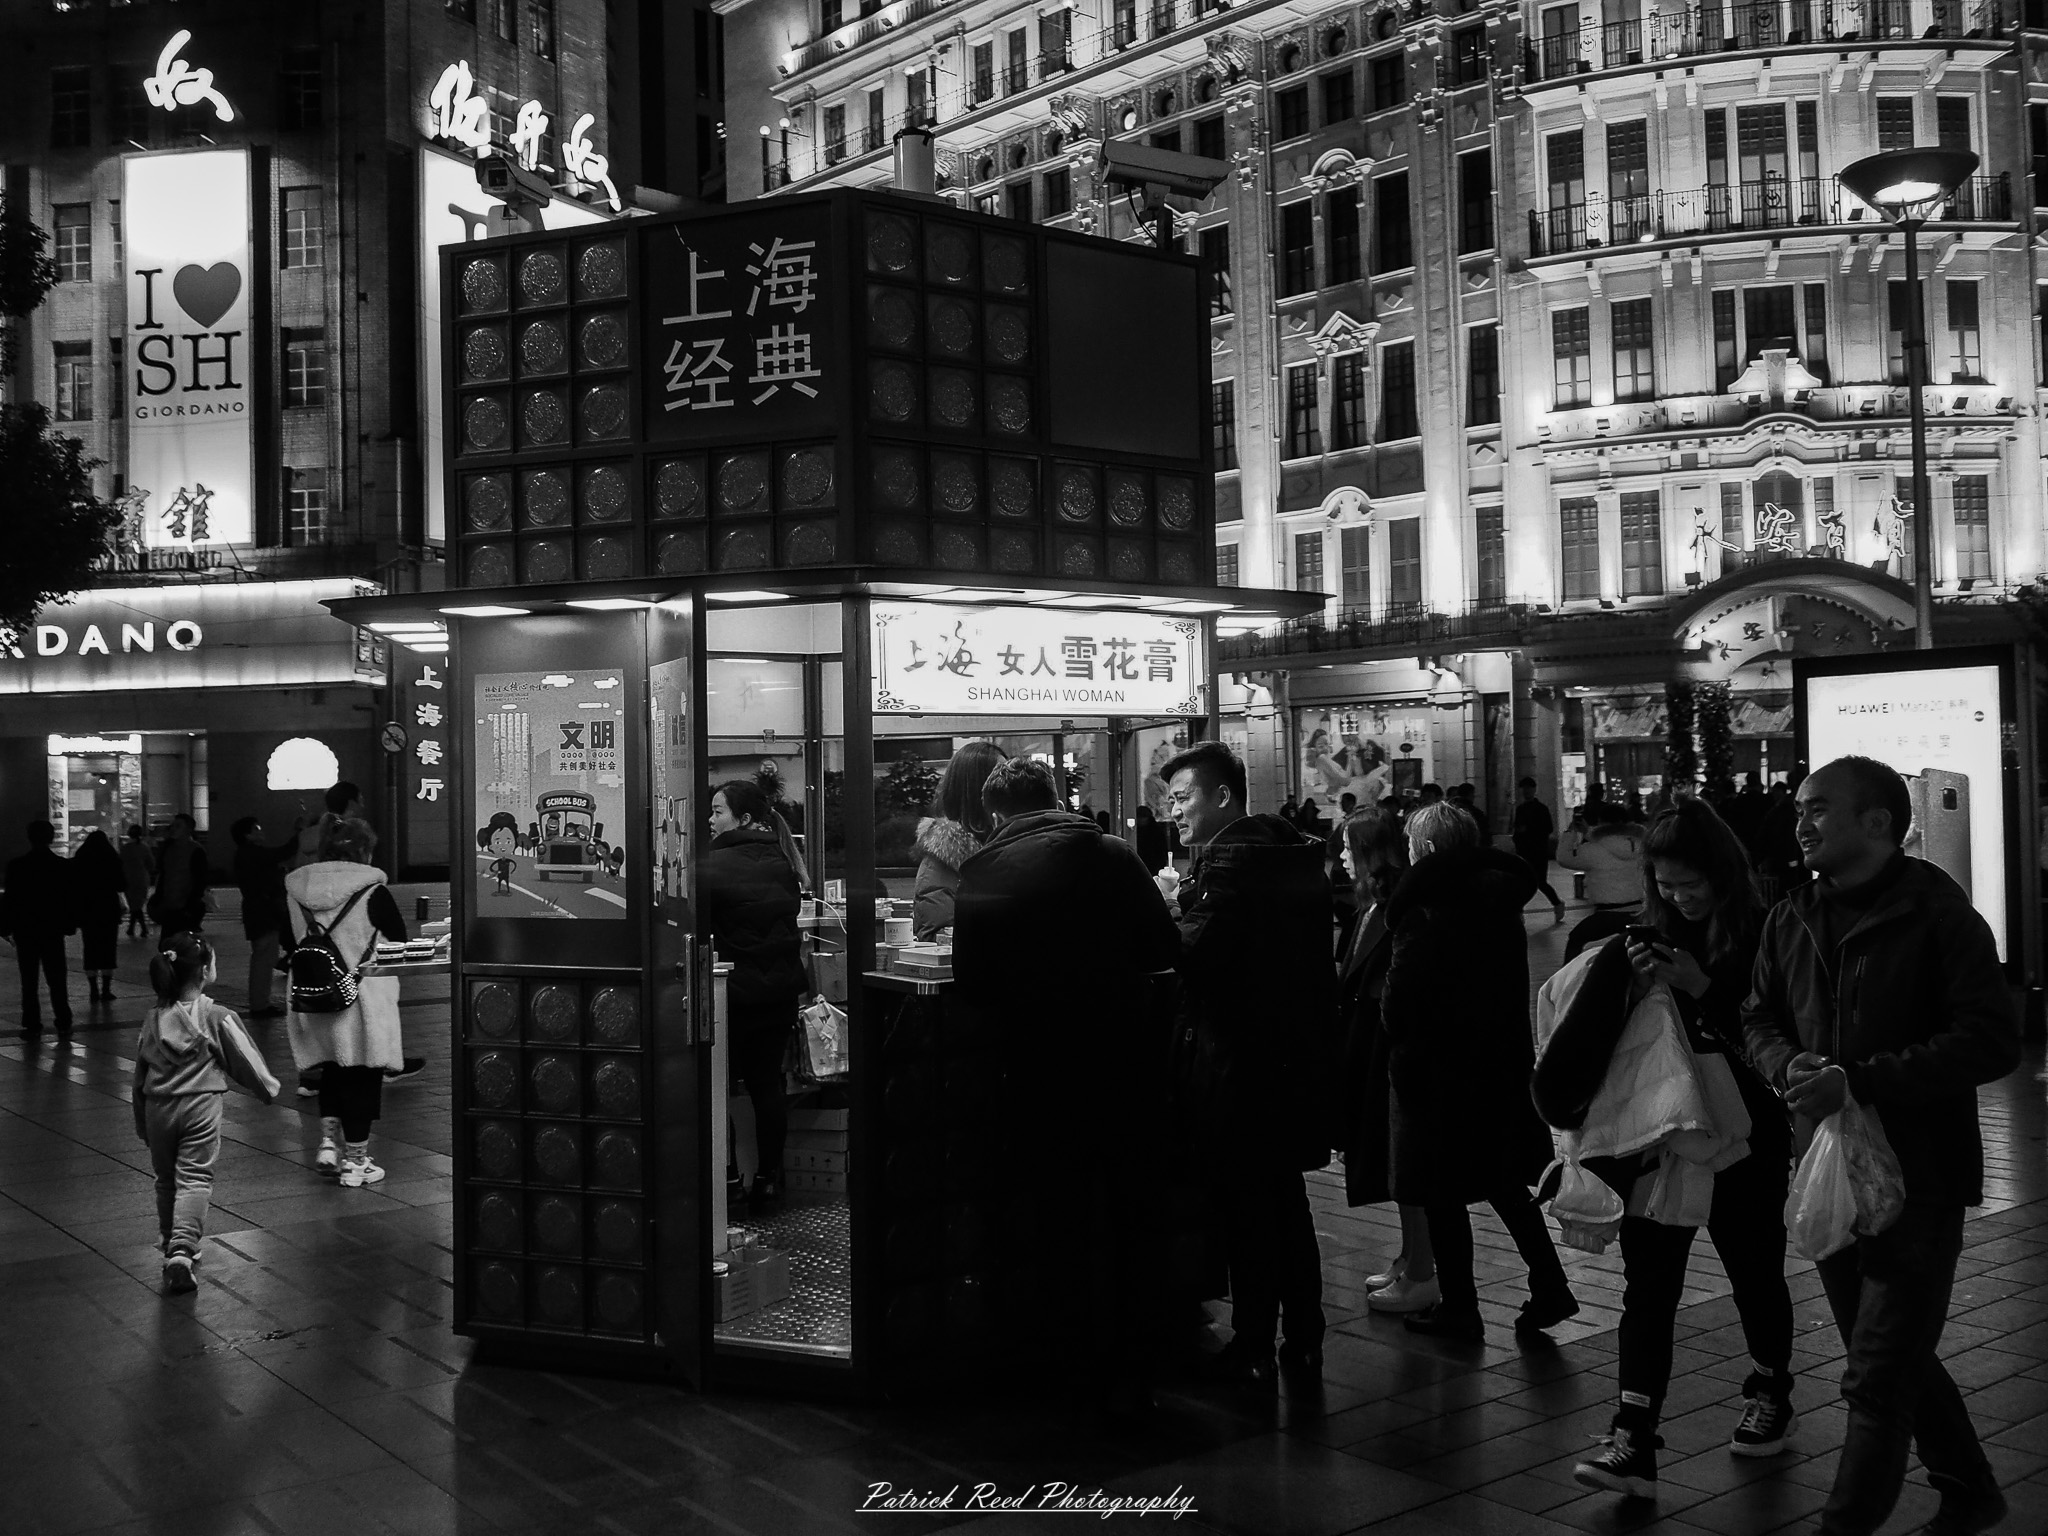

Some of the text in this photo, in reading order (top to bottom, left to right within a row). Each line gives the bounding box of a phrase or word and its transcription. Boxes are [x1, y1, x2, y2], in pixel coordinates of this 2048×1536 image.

[663, 237, 818, 325] 上海
[135, 268, 164, 330] I
[136, 331, 242, 397] SH
[663, 323, 821, 412] 经典
[135, 401, 245, 420] GIORDANO
[967, 686, 1126, 703] SHANGHAI WOMAN
[1837, 702, 1896, 716] HUAWEI
[415, 665, 445, 802] 上海餐厅
[559, 720, 615, 752] 文明
[559, 760, 616, 772] 共创美好社会
[545, 796, 587, 807] SCHOOL BUS
